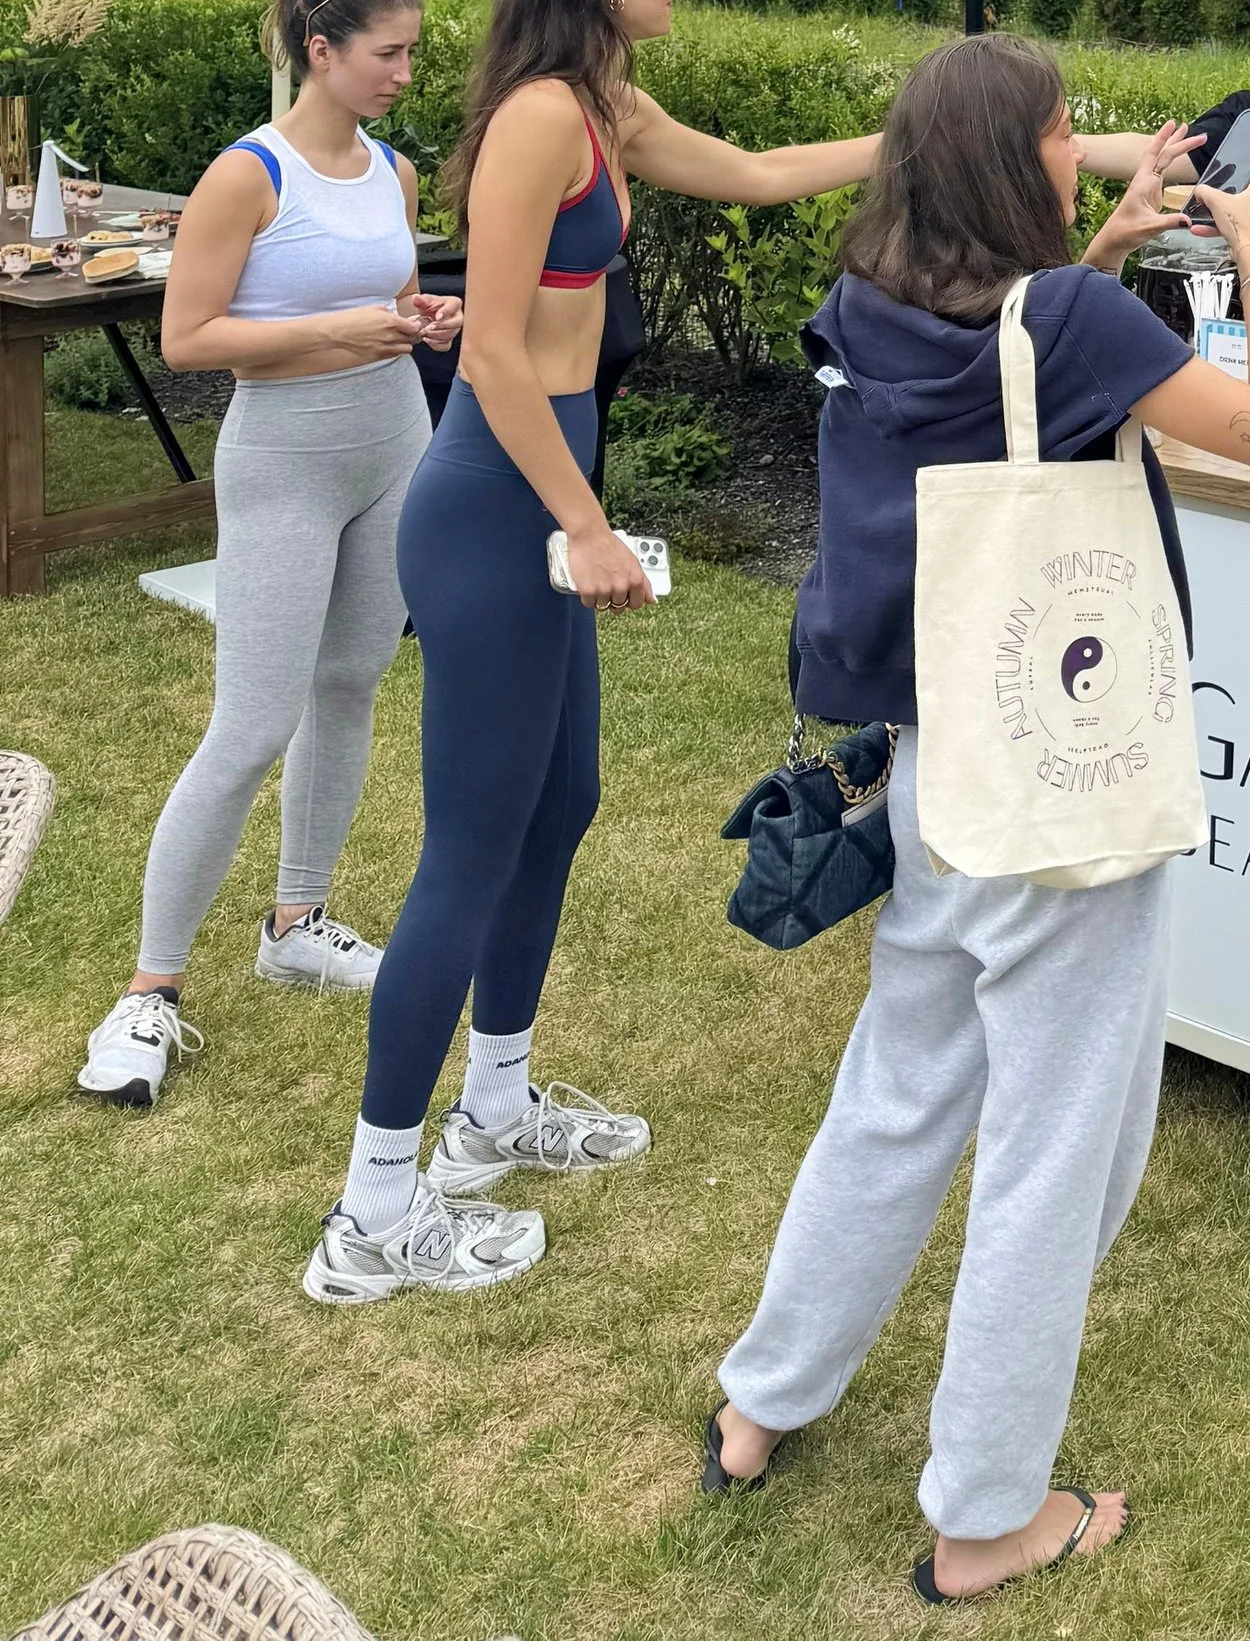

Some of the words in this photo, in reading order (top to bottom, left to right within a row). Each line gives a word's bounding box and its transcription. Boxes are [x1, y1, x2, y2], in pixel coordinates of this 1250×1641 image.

[1040, 549, 1137, 591] WINTER
[995, 596, 1036, 741] AUTUMN
[1151, 603, 1177, 724] SPRING
[1036, 741, 1150, 793] SUMMER
